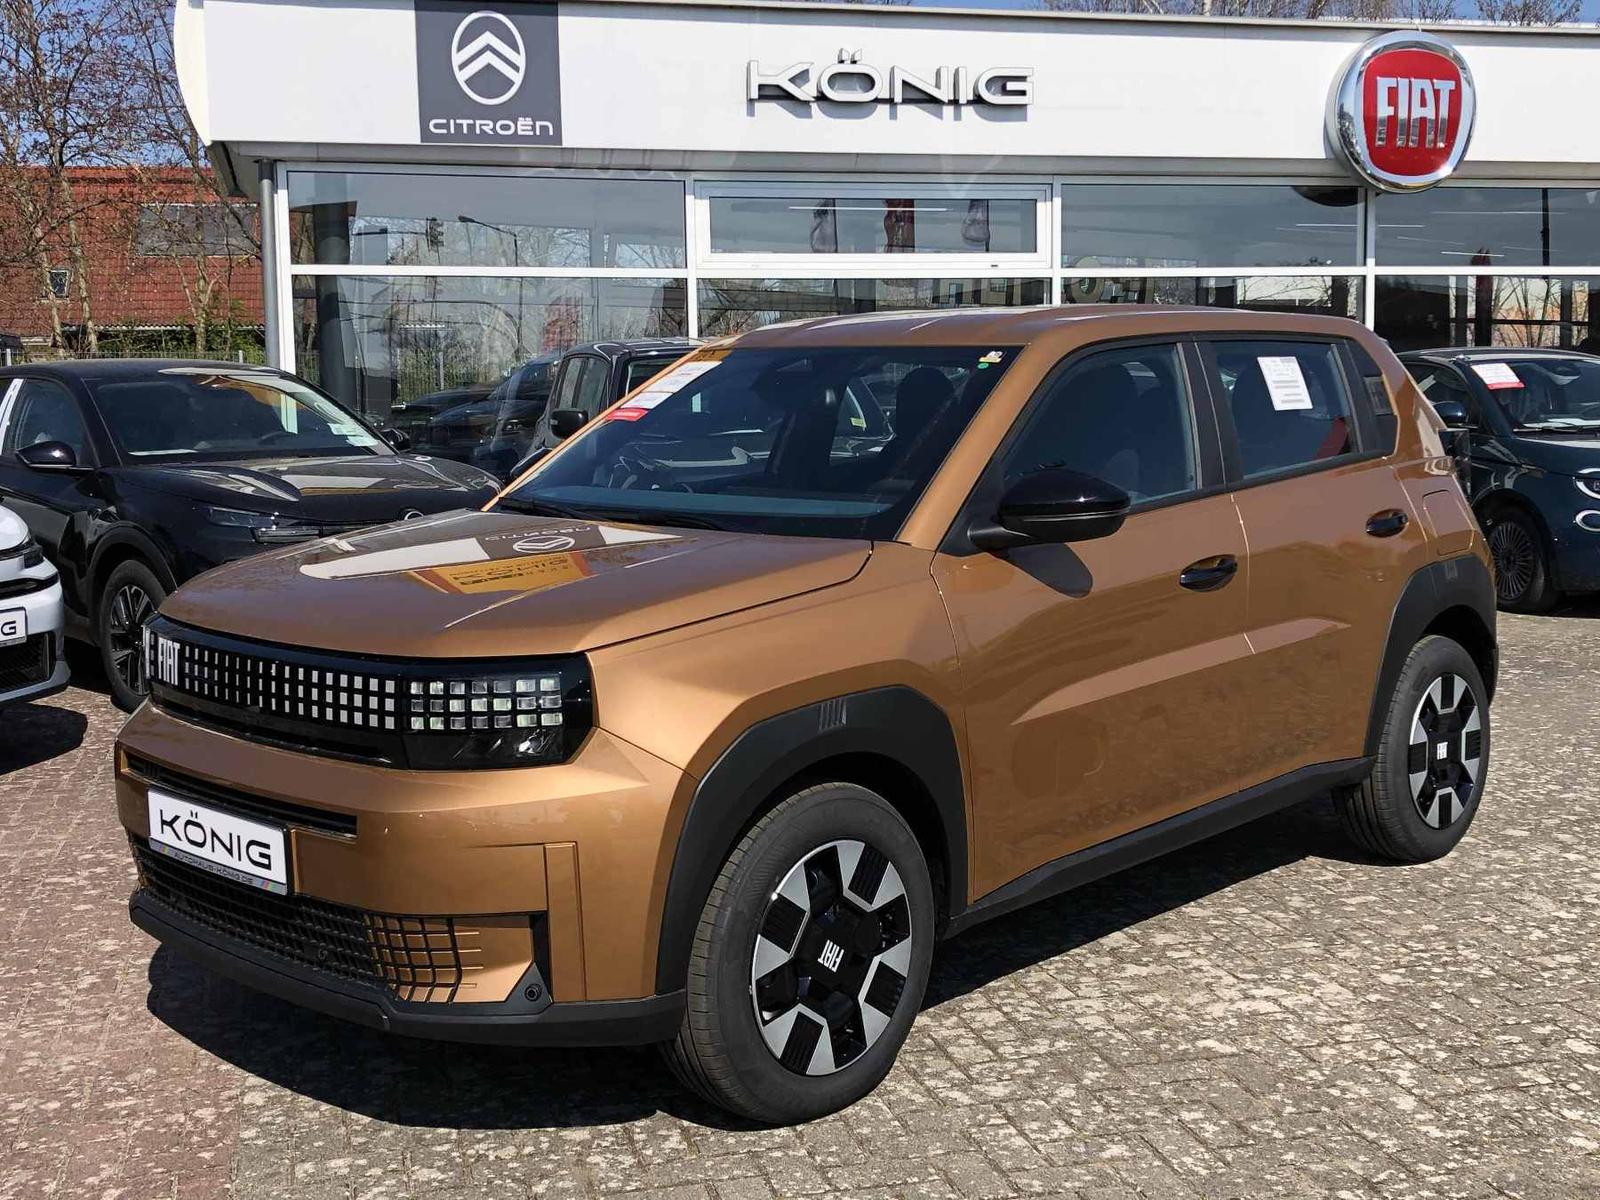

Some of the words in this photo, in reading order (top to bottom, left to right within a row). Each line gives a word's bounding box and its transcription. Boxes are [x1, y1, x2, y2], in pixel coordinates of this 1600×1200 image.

[746, 48, 1034, 105] KÖNIG
[428, 116, 554, 136] CITROËN
[1375, 76, 1456, 149] FIAT
[157, 636, 181, 686] FIAT
[159, 809, 272, 871] KÖNIG
[817, 939, 845, 973] FIAT
